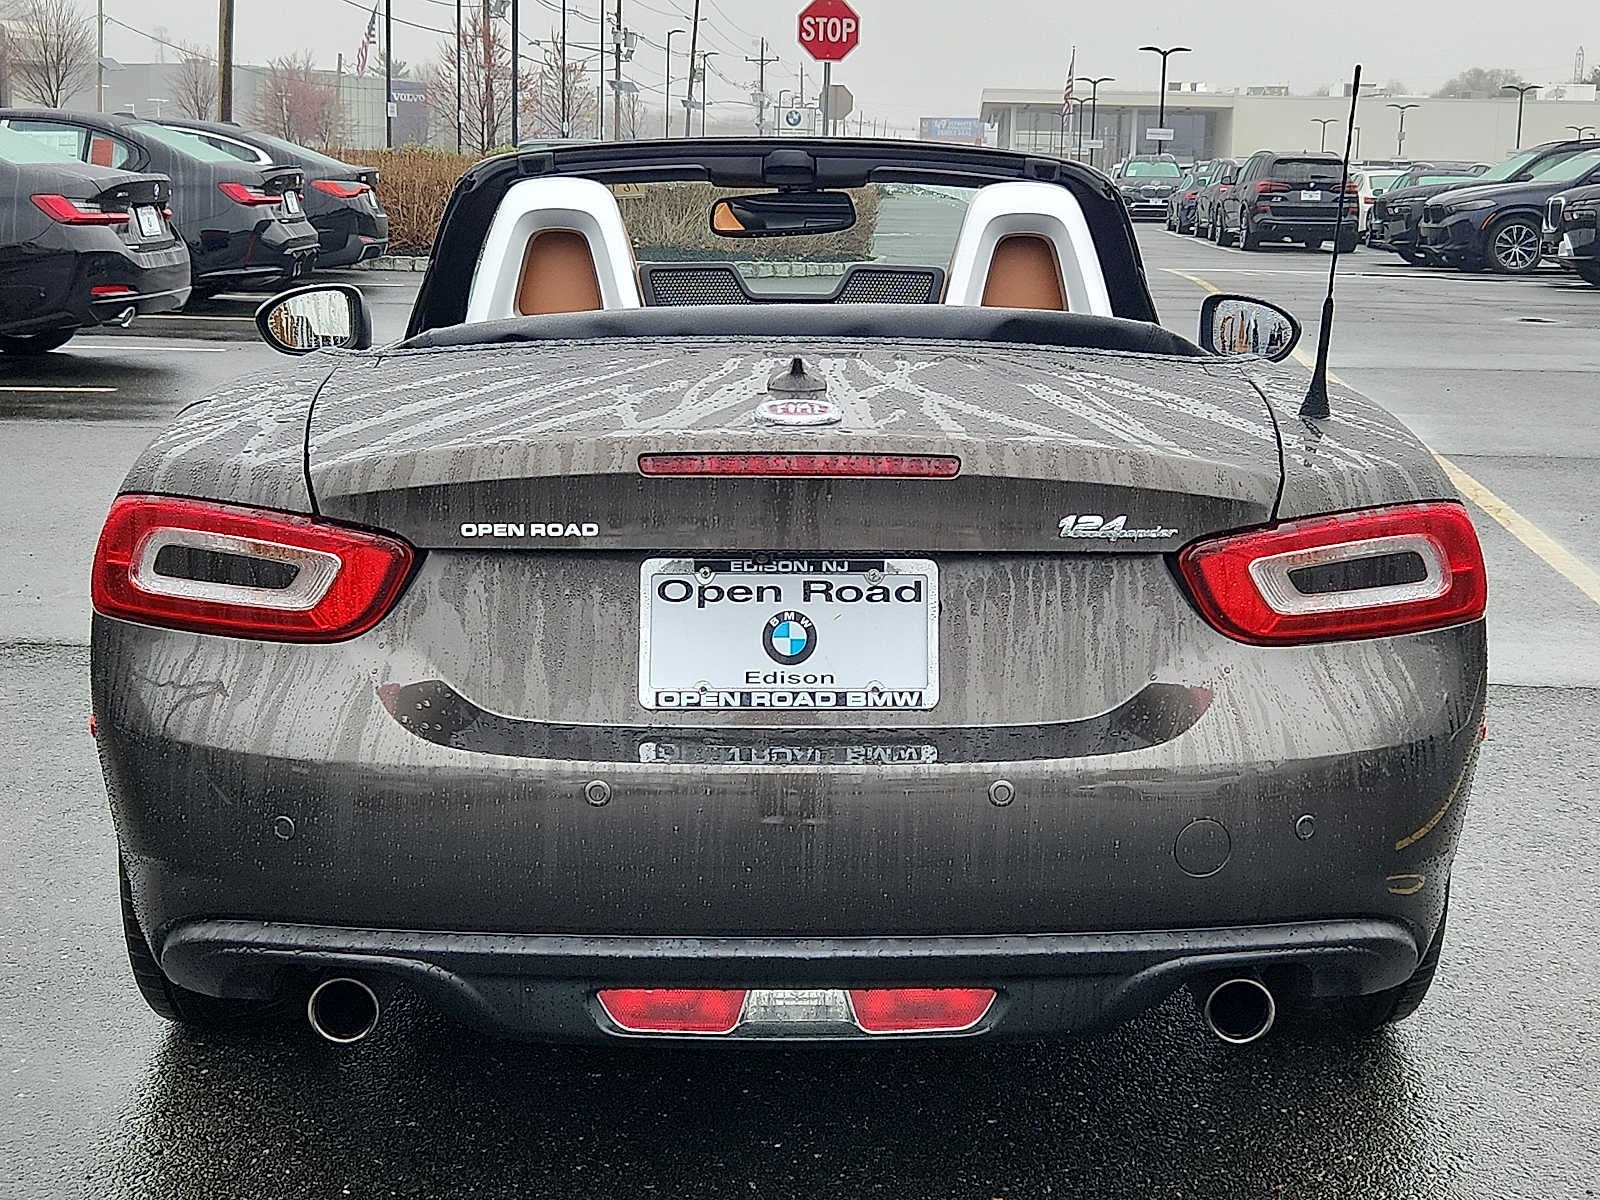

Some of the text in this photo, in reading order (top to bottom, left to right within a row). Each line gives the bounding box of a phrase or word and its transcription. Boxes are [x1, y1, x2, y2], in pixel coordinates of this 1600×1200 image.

[801, 16, 857, 42] STOP
[391, 92, 426, 102] VOLVO
[460, 523, 599, 537] OPEN ROAD
[1059, 514, 1127, 538] 124
[822, 560, 849, 573] NJ
[657, 579, 782, 608] Open
[802, 579, 922, 603] Road
[769, 611, 812, 628] BMW
[745, 671, 834, 684] Edison
[658, 691, 920, 706] OPEN ROAD BMW
